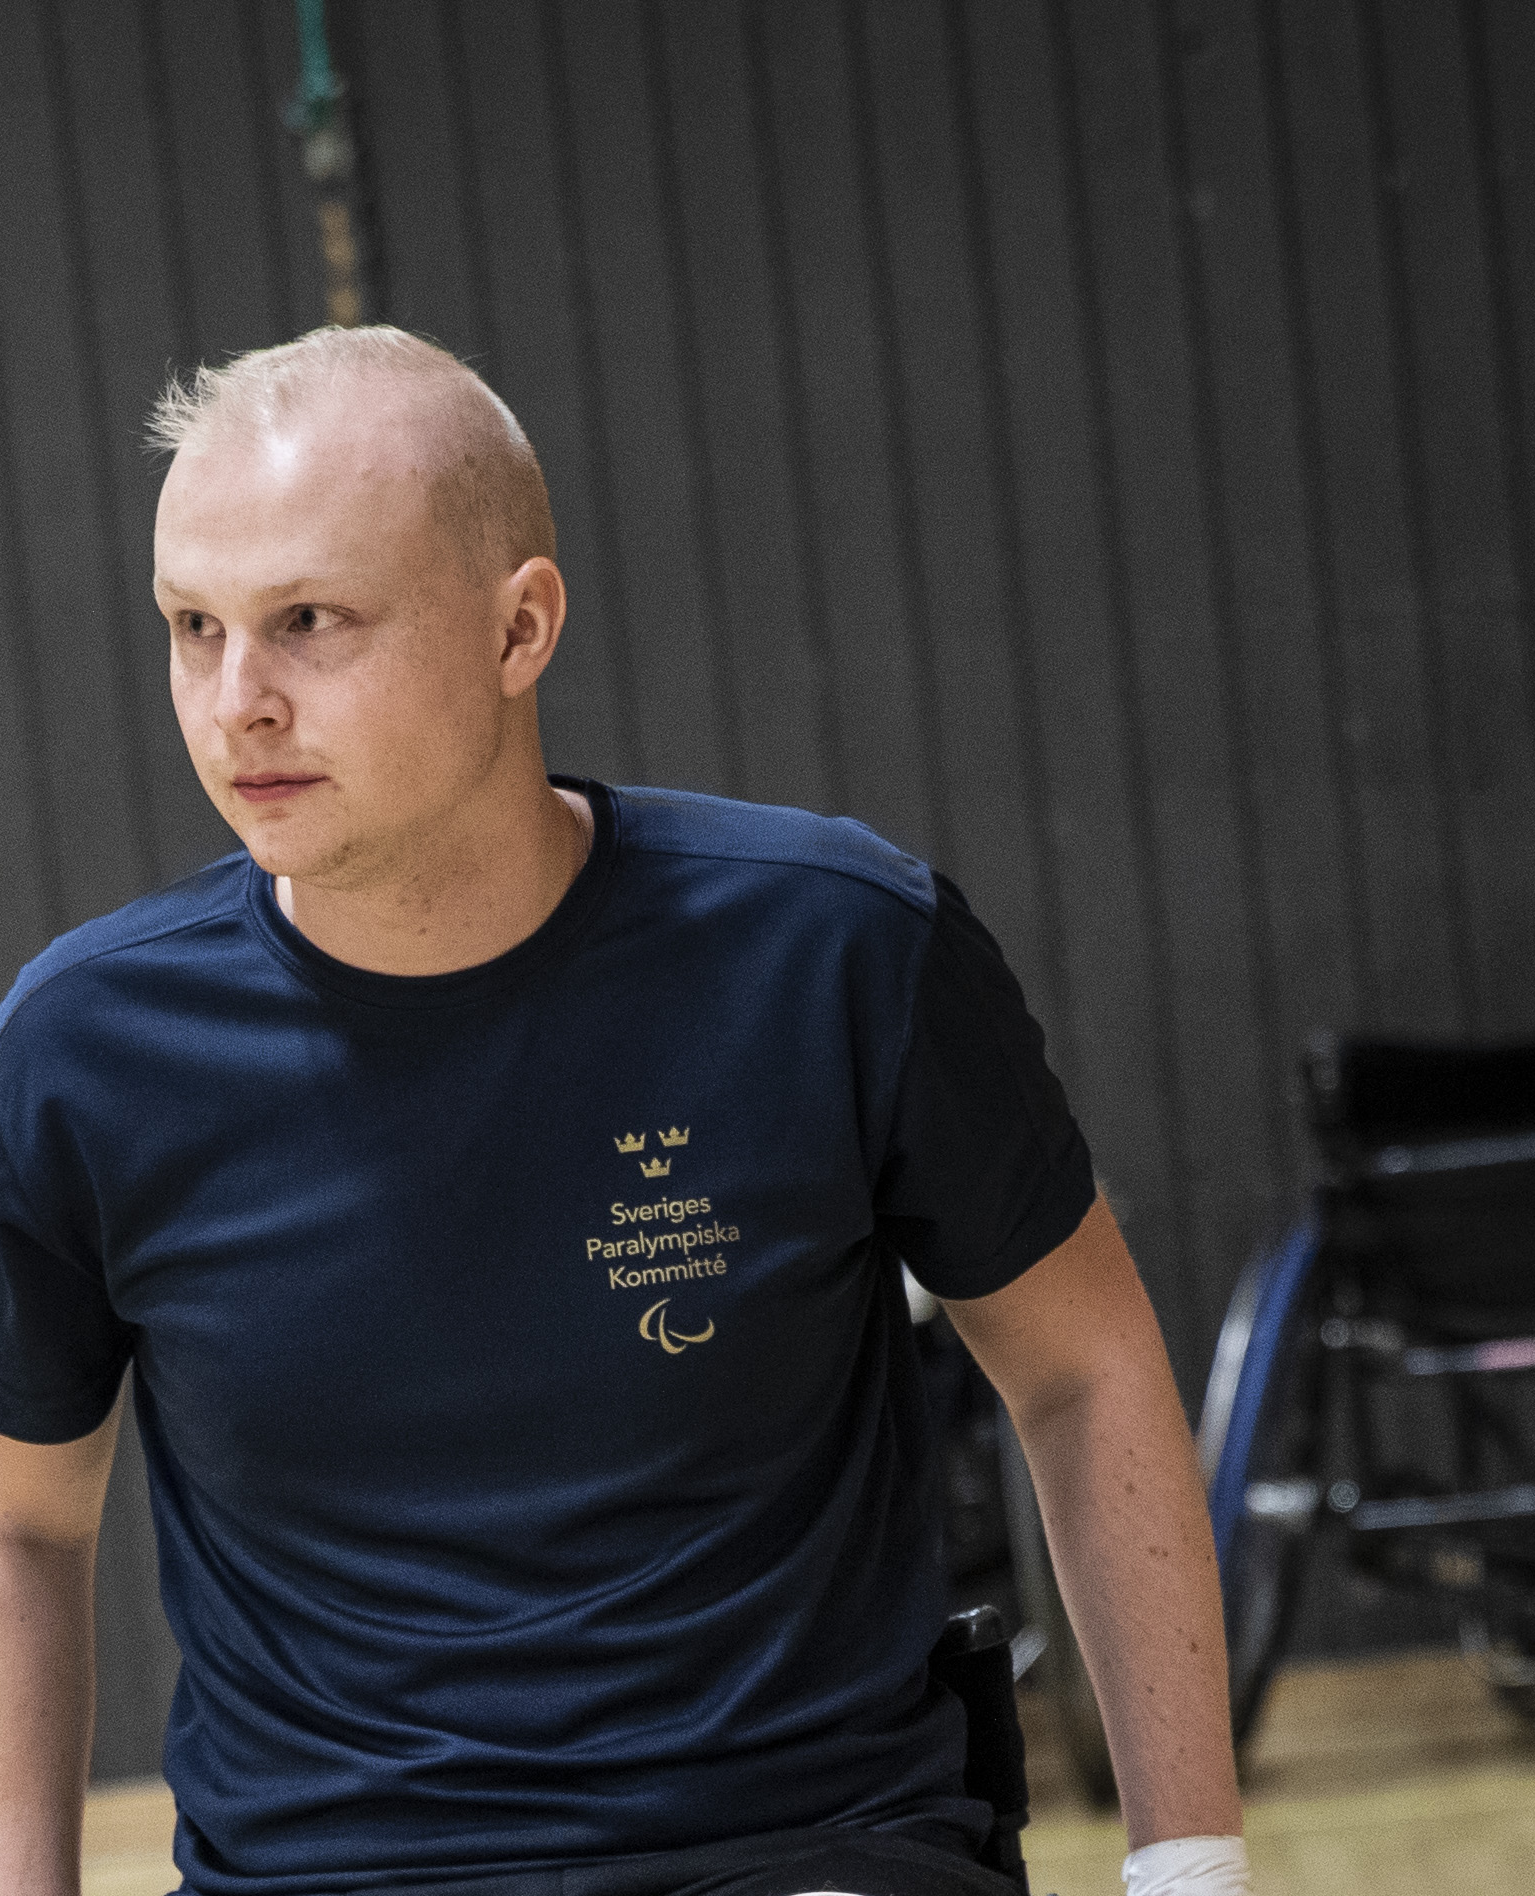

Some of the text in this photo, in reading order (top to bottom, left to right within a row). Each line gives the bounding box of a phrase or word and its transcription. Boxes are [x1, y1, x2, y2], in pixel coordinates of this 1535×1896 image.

[610, 1197, 711, 1225] Sveriges
[586, 1221, 740, 1261] Paralympiska
[609, 1253, 727, 1289] Kommitté
